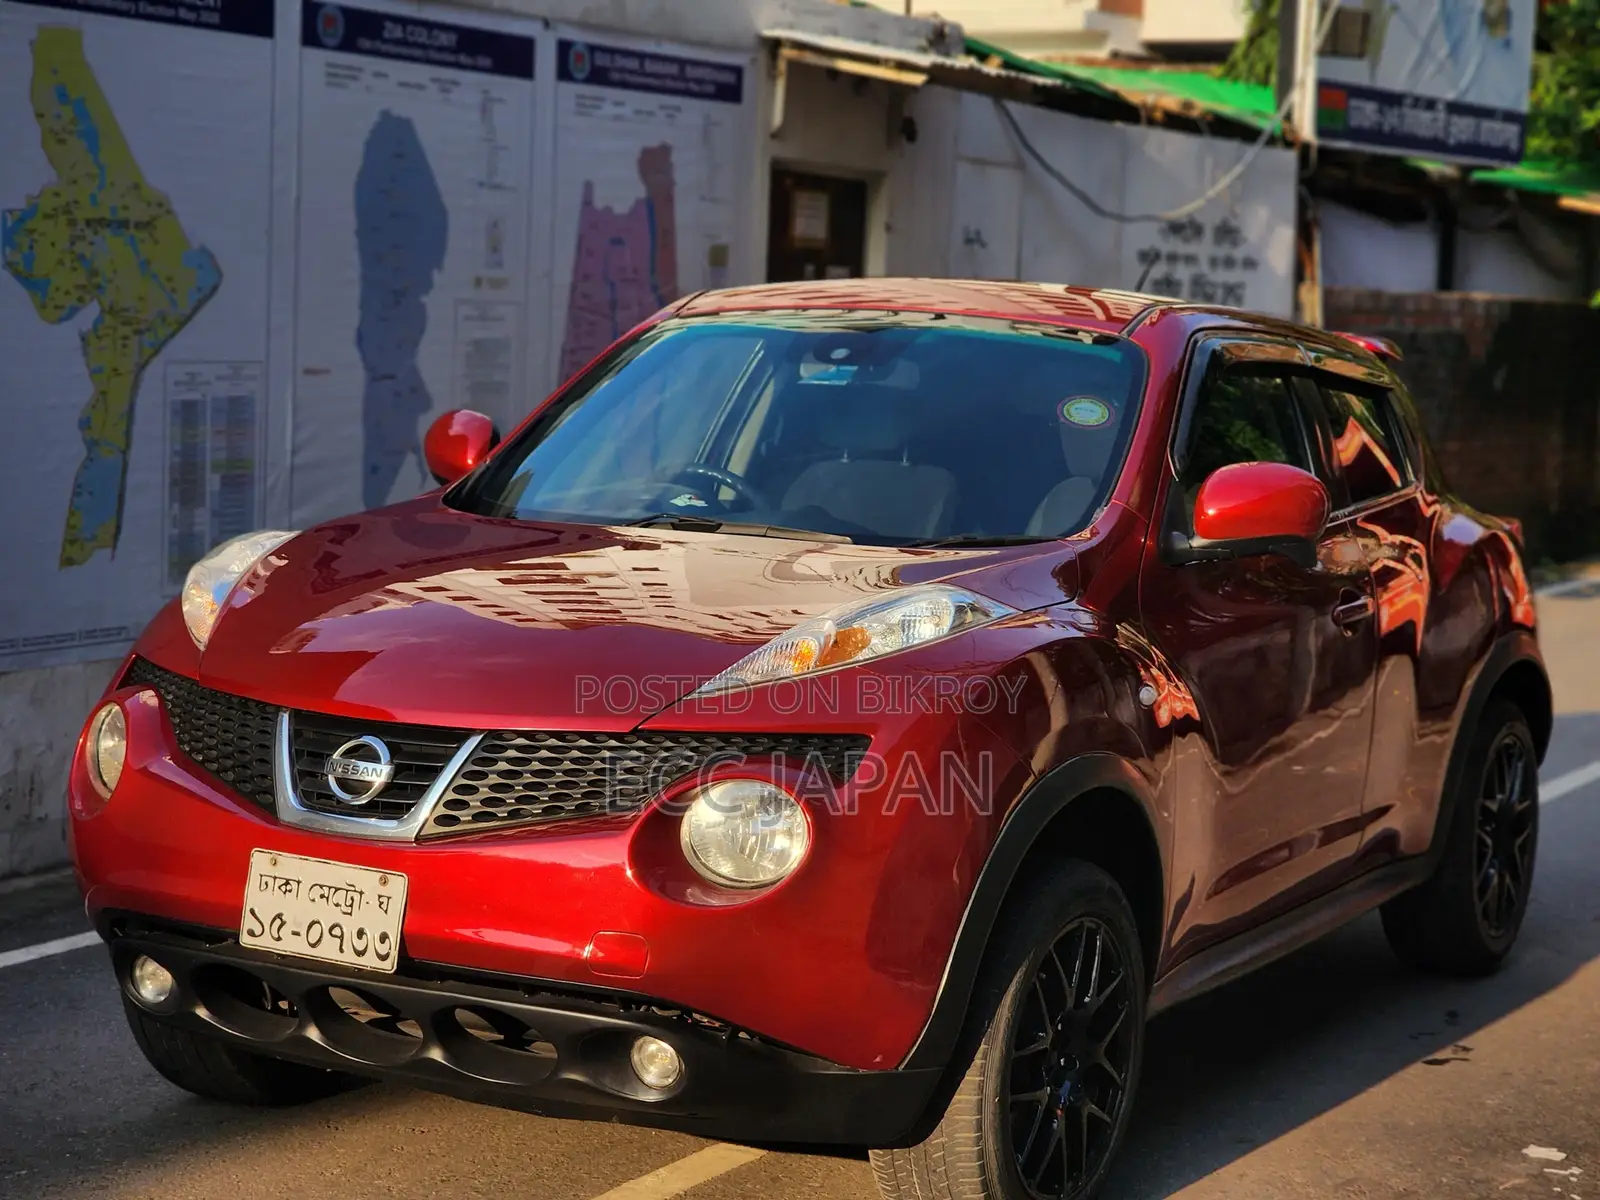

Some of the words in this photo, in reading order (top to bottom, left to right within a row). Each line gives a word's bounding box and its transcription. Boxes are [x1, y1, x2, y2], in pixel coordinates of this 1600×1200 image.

[328, 761, 383, 778] NISSAN
[258, 873, 302, 900] ঢাকা
[246, 907, 393, 962] ১৫-০৭৩৩
